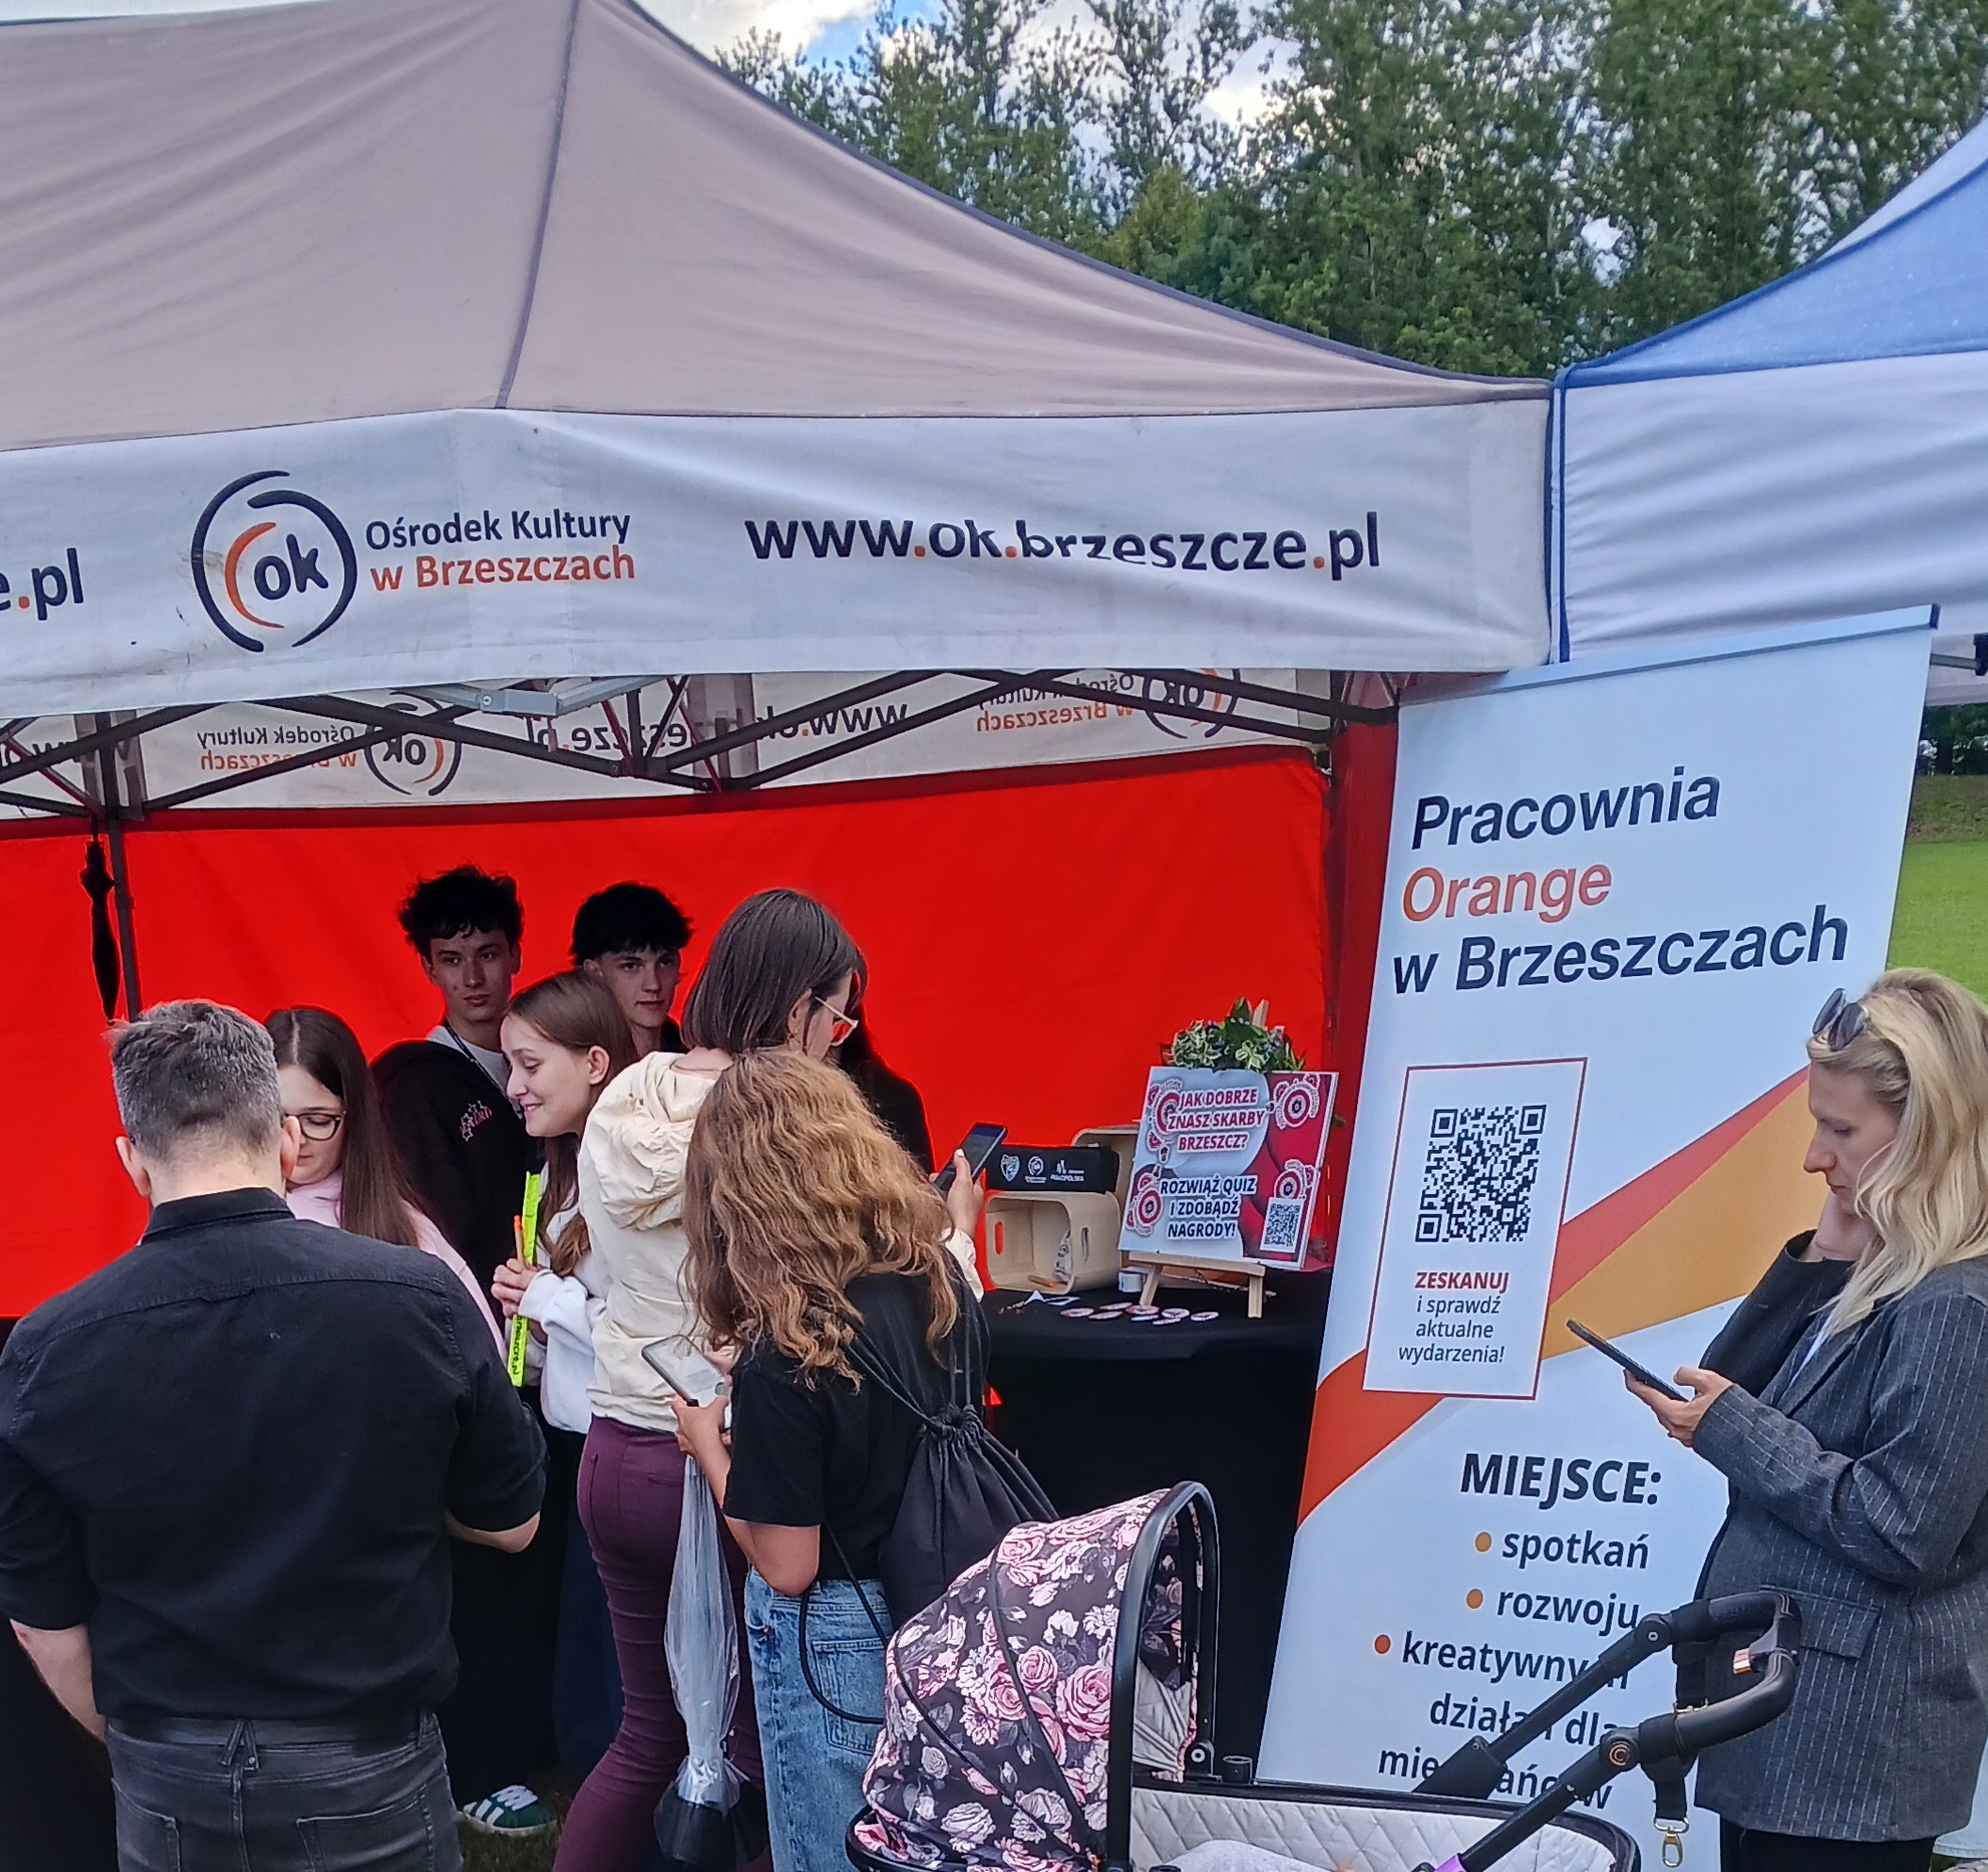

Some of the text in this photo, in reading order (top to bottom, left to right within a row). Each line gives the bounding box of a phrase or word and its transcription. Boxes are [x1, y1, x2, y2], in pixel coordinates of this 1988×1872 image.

[365, 510, 631, 551] Ośrodek Kultury
[744, 511, 1380, 581] www.ok.brzeszcze.pl
[253, 533, 328, 601] ok
[371, 544, 636, 592] w Brzeszczach
[1411, 766, 1721, 850] Pracownia
[1402, 863, 1612, 922] Orange
[1393, 904, 1849, 994] w Brzeszczach
[1178, 1089, 1258, 1110] JAK DOBRZE
[1168, 1110, 1265, 1130] ZNASZ SKARBY
[1178, 1134, 1249, 1152] BRZESZCZ?
[1160, 1175, 1256, 1196] ROZWIĄŹ QUIZ
[1170, 1198, 1239, 1219] I ZDOBĄDŹ
[1168, 1222, 1236, 1238] NAGRODY!
[1414, 1271, 1509, 1294] ZESKANUJ
[1416, 1295, 1502, 1318] i sprawdź
[1415, 1319, 1494, 1340] aktualne
[1398, 1343, 1505, 1366] wydarzenia!
[1460, 1453, 1662, 1510] MIEJSCE:
[1501, 1530, 1649, 1569] spotkań
[1497, 1590, 1640, 1636] rozwoju
